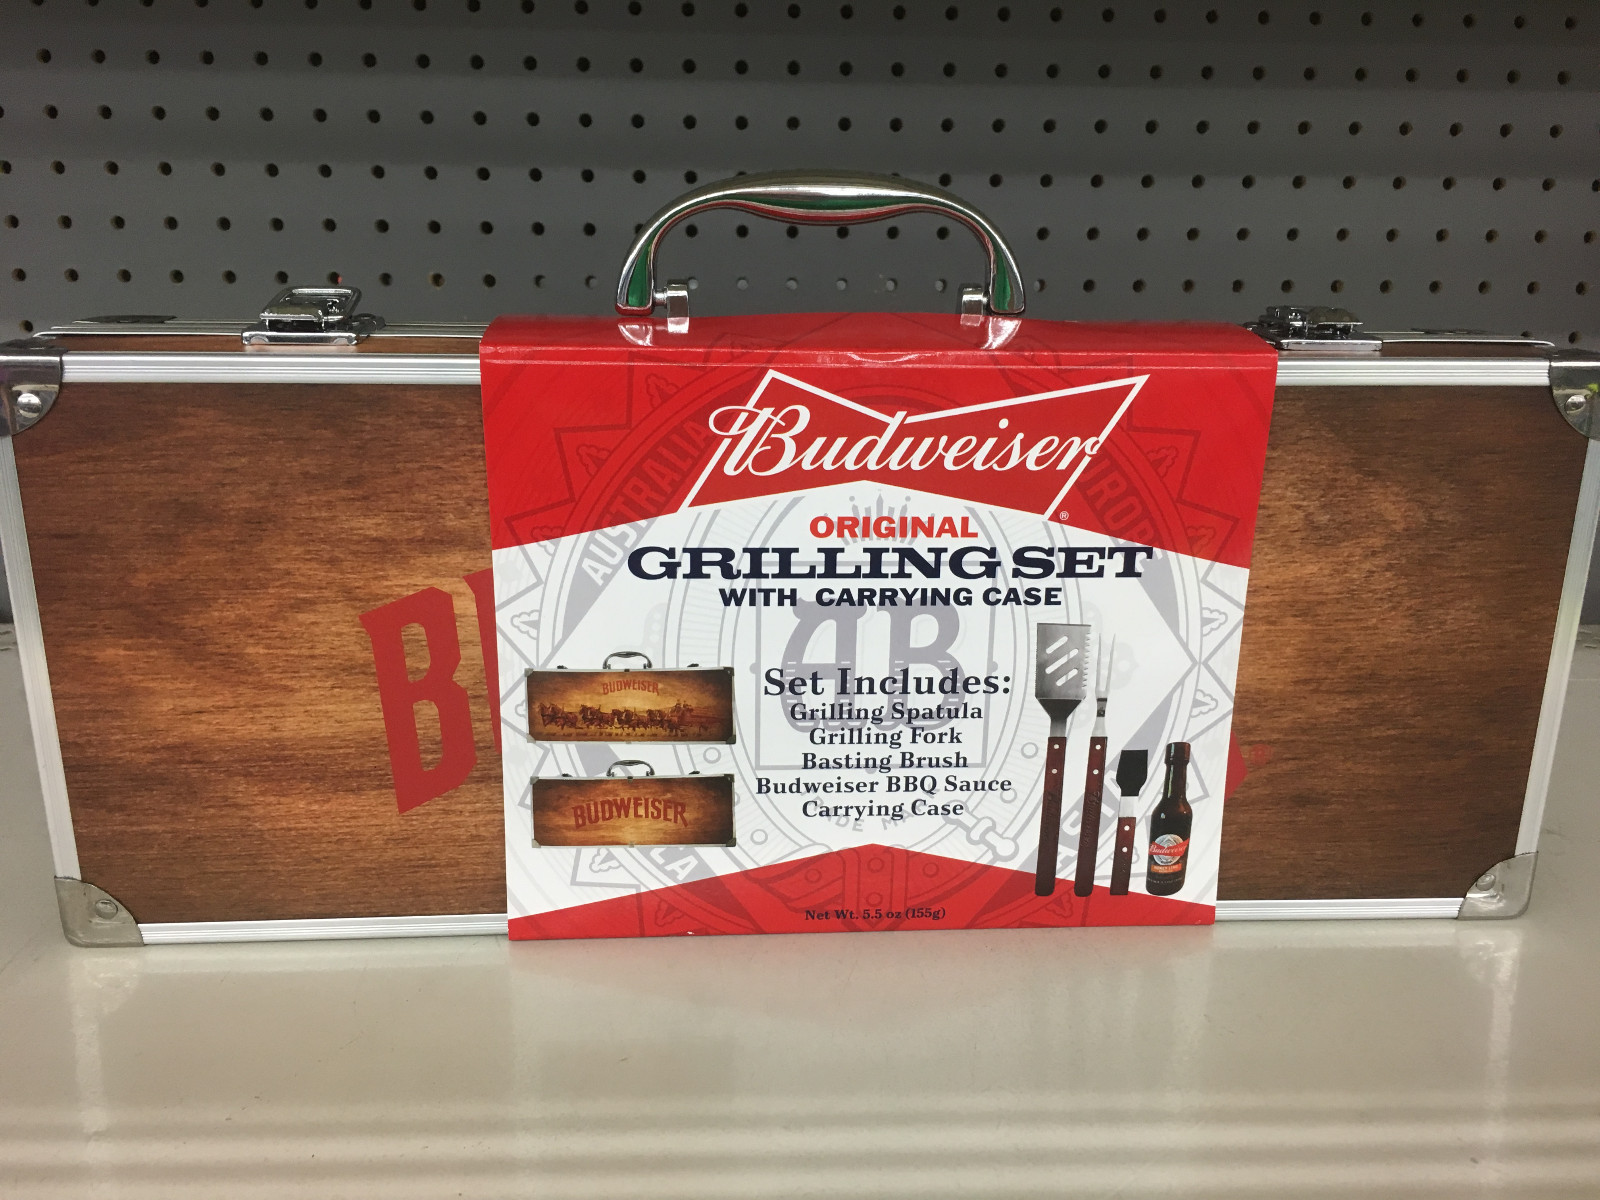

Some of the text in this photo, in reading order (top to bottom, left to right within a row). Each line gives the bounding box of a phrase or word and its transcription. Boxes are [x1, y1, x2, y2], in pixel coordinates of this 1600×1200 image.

[708, 404, 1101, 477] Budweiser
[581, 419, 711, 587] AUSTRALIA
[809, 515, 979, 539] ORIGINAL
[627, 546, 1154, 581] GRILLING SET
[718, 587, 1063, 607] WITH CARRYING CASE
[602, 679, 660, 696] BUDWEISER
[764, 667, 1011, 697] Set Includes:
[790, 701, 983, 725] Grilling Spatula
[809, 727, 963, 750] Grilling Fork
[801, 751, 969, 774] Basting Brush
[755, 775, 1013, 795] Budweiser BBQ Sauce
[572, 796, 689, 830] BUDWEISER
[802, 799, 965, 821] Carrying Case
[804, 907, 946, 921] Net Wt. 5.5 oz (155g)
